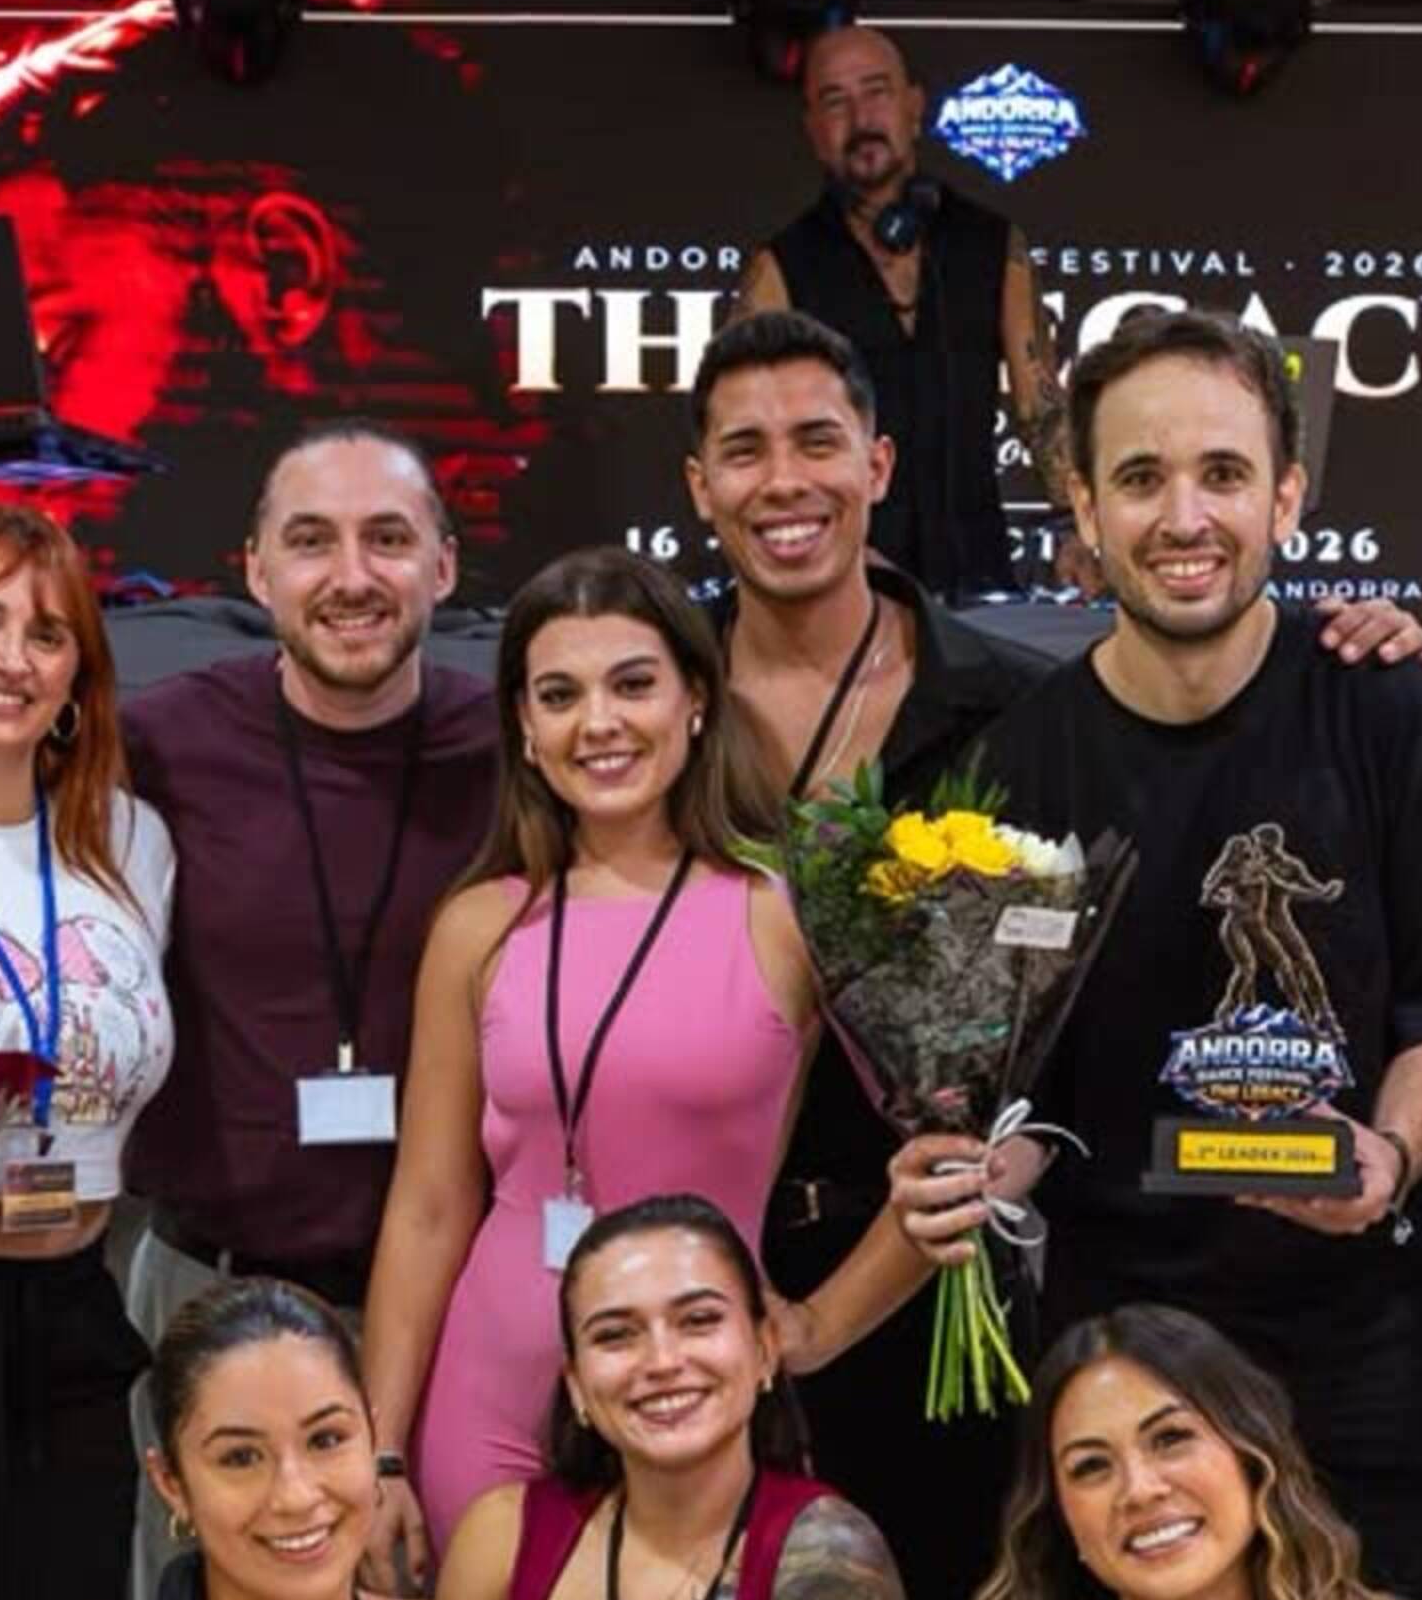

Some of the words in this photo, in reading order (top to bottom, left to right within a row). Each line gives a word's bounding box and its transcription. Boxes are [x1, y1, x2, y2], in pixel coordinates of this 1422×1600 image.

[936, 97, 1080, 129] ANDORRA
[574, 246, 741, 271] ANDOR
[482, 287, 740, 392] TH
[626, 526, 679, 561] 16
[1281, 528, 1380, 562] 026
[1266, 580, 1422, 600] ANDORRA
[1174, 1036, 1341, 1072] ANDORRA
